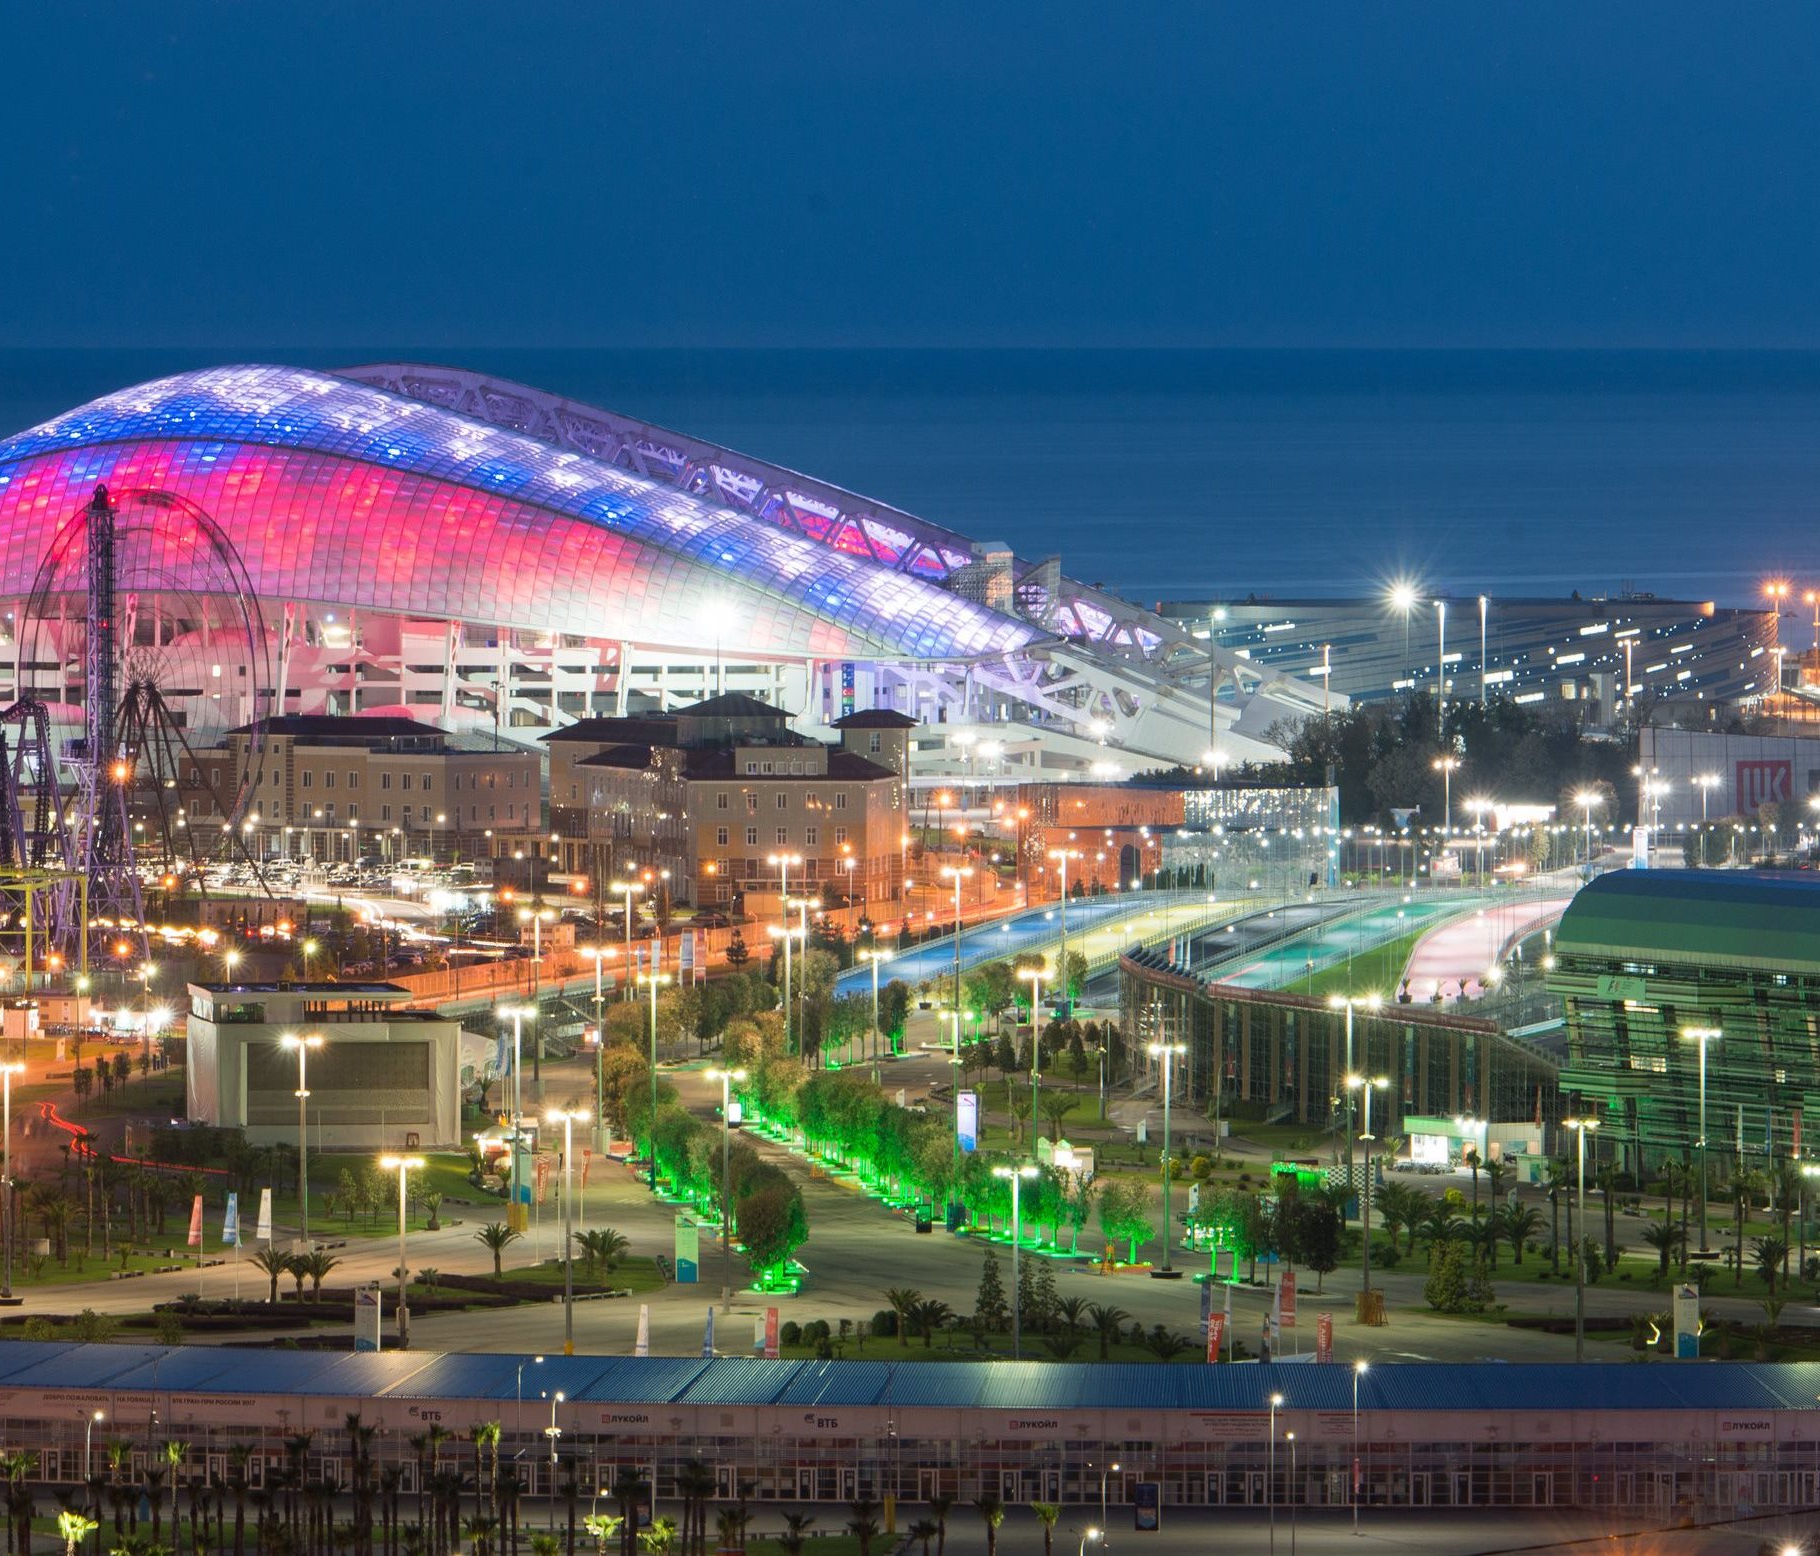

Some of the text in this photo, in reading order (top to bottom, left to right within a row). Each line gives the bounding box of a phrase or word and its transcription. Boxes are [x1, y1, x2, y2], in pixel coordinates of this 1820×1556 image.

[844, 706, 851, 717] 3
[421, 1411, 441, 1420] ВТБ
[611, 1414, 649, 1423] ЛУКОЙЛ
[817, 1418, 838, 1428] ВТБ
[1020, 1420, 1058, 1428] ЛУКОЙЛ
[1732, 1421, 1770, 1430] ЛУКОЙЛ
